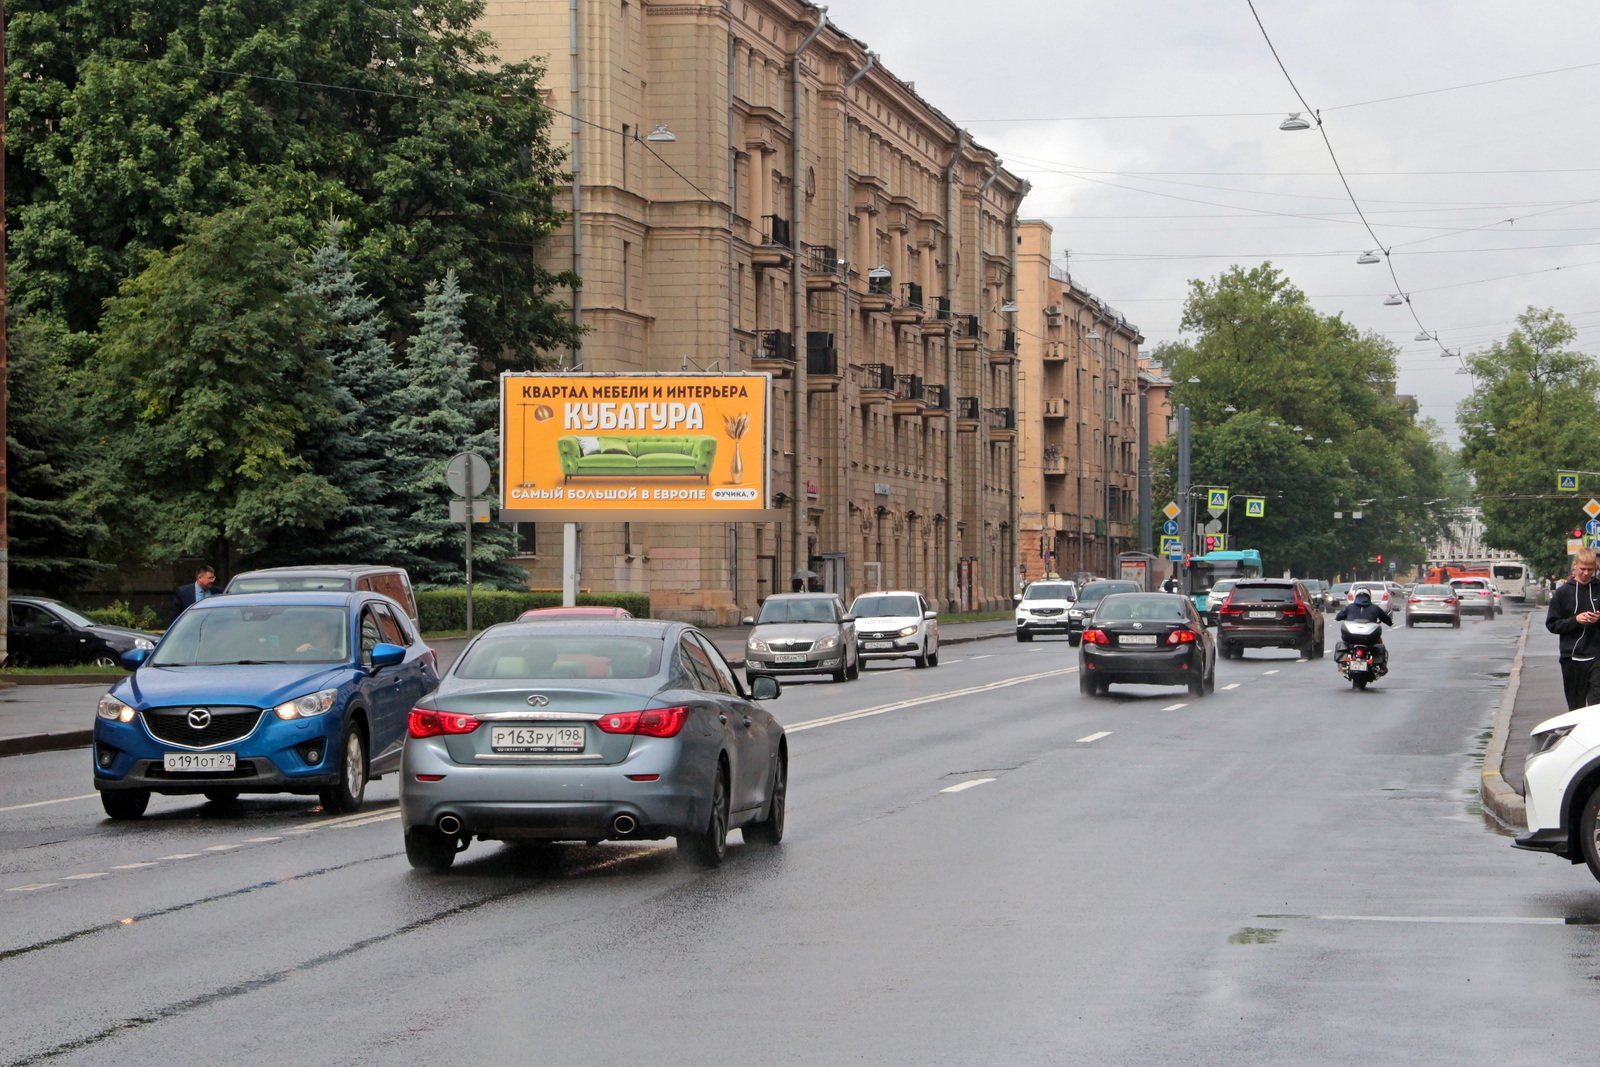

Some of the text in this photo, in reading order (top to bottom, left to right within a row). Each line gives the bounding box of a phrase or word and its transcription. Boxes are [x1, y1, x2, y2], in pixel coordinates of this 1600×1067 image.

[522, 385, 748, 398] КВАРТАЛ МЕБЕЛИ И ИНТЕРЬЕРА
[564, 402, 704, 430] КУБАТУРА
[511, 486, 707, 500] САМЫЙ БОЛЬШОЙ В ЕВРОПЕ
[496, 729, 580, 745] Р163РУ 198
[219, 754, 232, 764] 29
